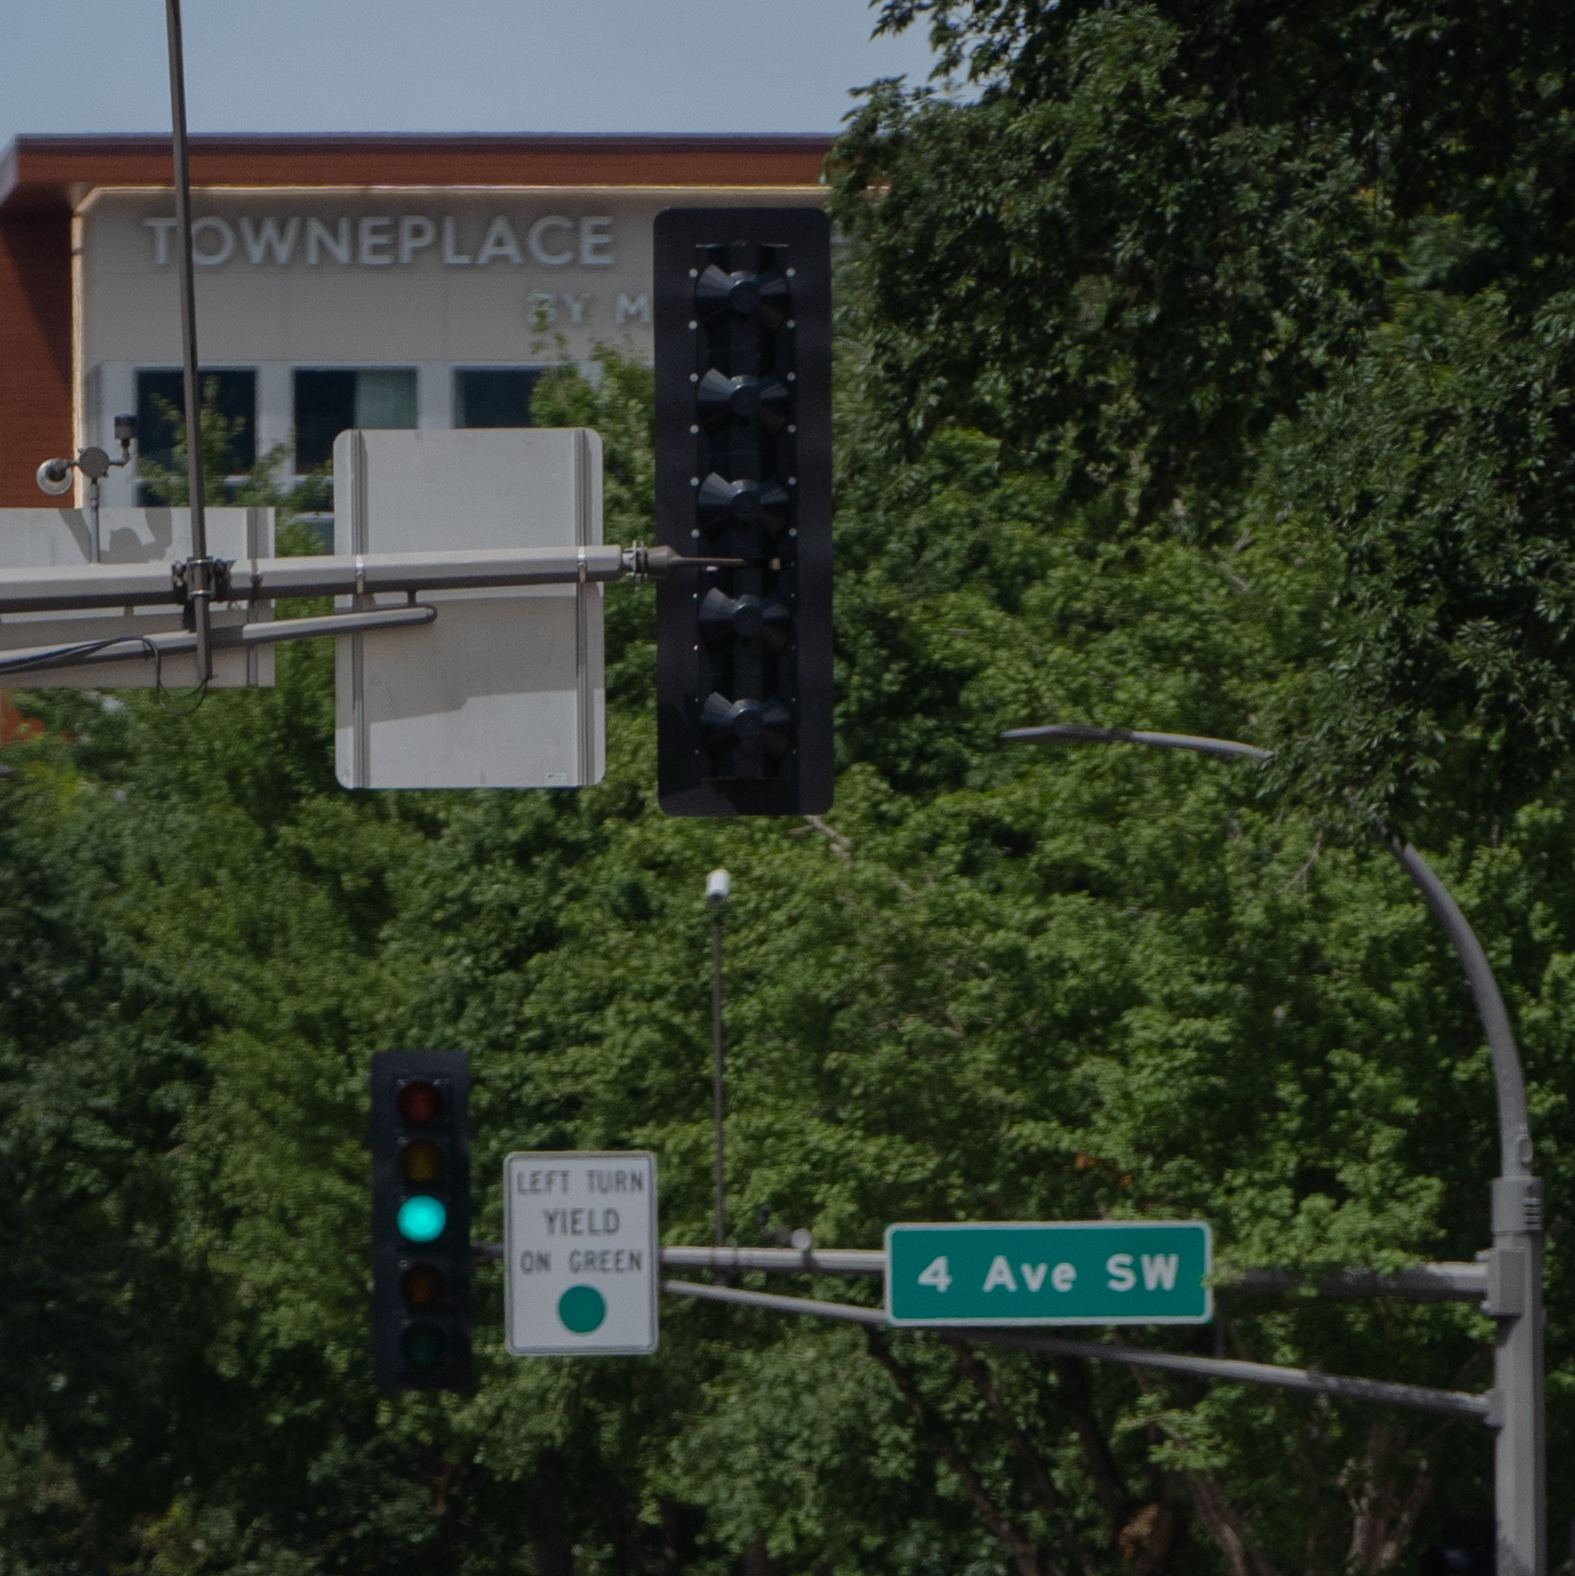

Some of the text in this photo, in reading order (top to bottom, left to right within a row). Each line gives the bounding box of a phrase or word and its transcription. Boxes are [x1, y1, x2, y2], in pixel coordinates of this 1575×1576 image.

[142, 213, 616, 267] TOWNEPLACE
[527, 291, 594, 326] BY
[516, 1170, 645, 1195] LEFT TURN
[543, 1207, 621, 1236] YIELD
[520, 1249, 644, 1274] ON GREEN
[916, 1252, 1181, 1293] 4 Ave SW
